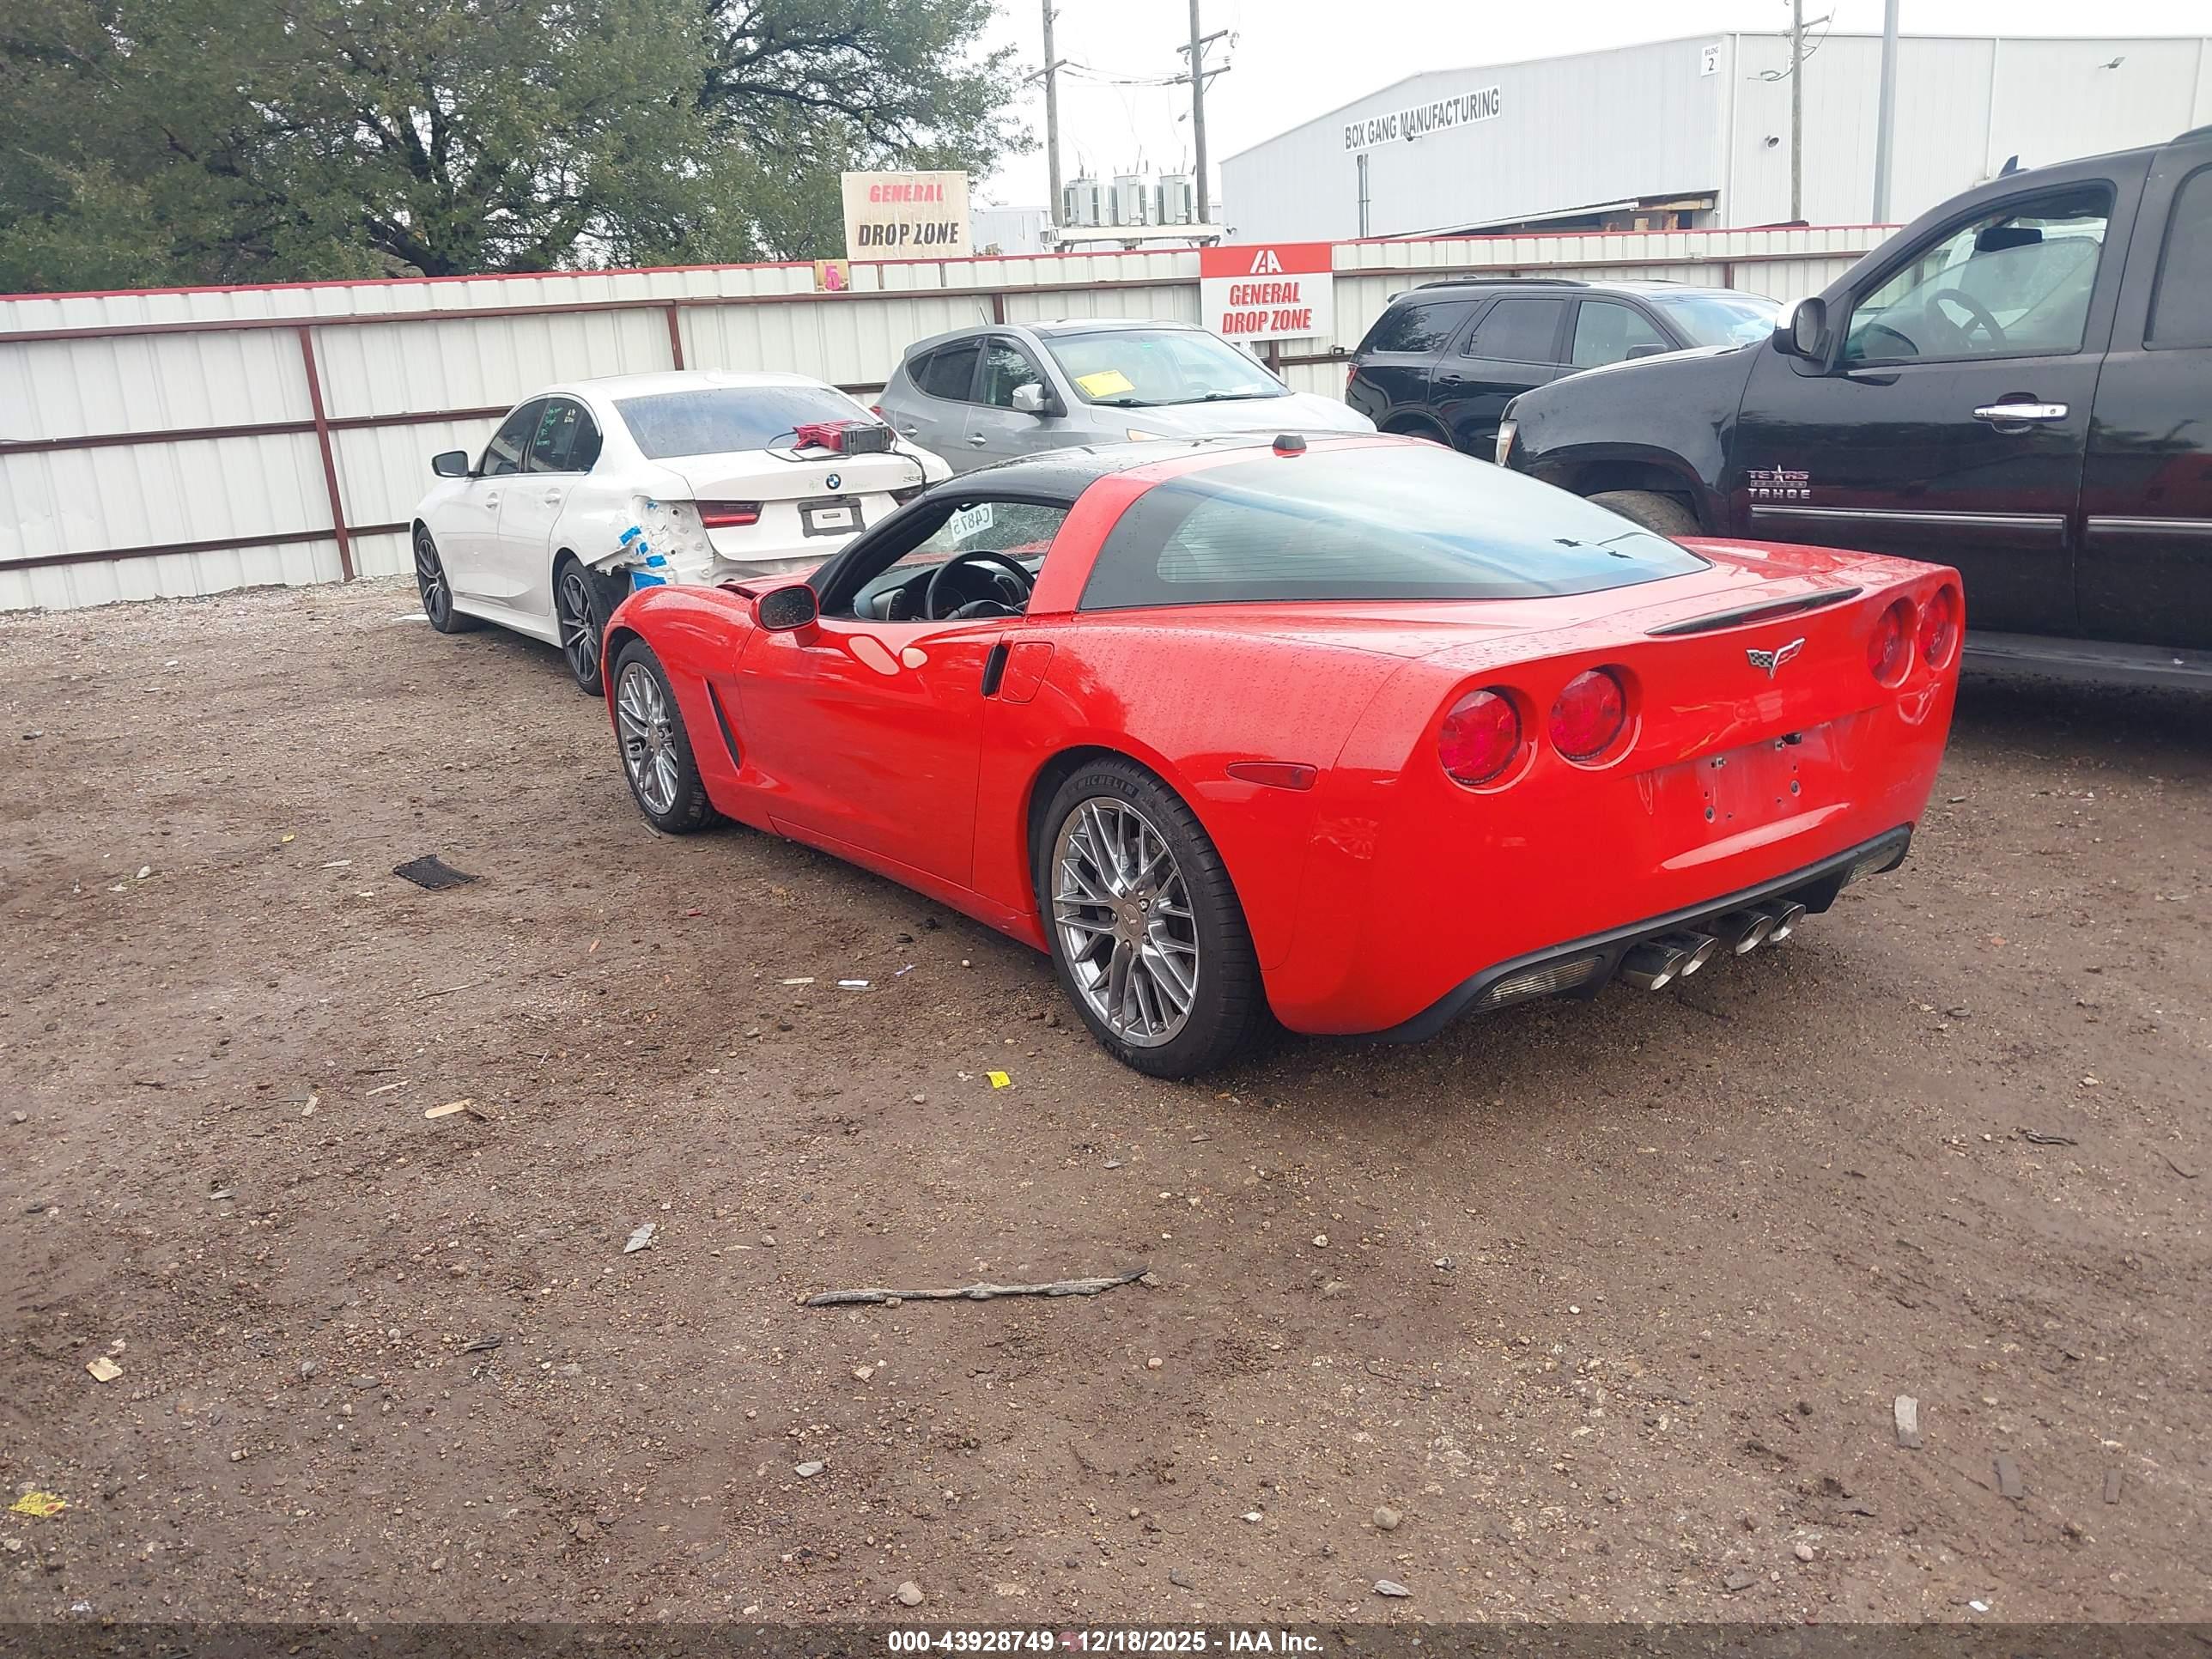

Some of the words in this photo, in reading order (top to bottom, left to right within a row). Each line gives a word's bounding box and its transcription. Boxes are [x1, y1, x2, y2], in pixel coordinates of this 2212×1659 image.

[1708, 58, 1715, 71] 2
[1345, 123, 1365, 150] BOX
[1368, 114, 1397, 144] GANG
[1401, 88, 1499, 137] MANUFACTURING
[869, 184, 944, 203] GENERAL
[859, 223, 909, 246] DROP
[913, 222, 959, 245] ZONE
[824, 265, 840, 290] 5
[1230, 283, 1300, 307] GENERAL
[1222, 311, 1268, 336] DROP
[1270, 308, 1313, 331] ZONE
[1748, 488, 1810, 498] TAHOE
